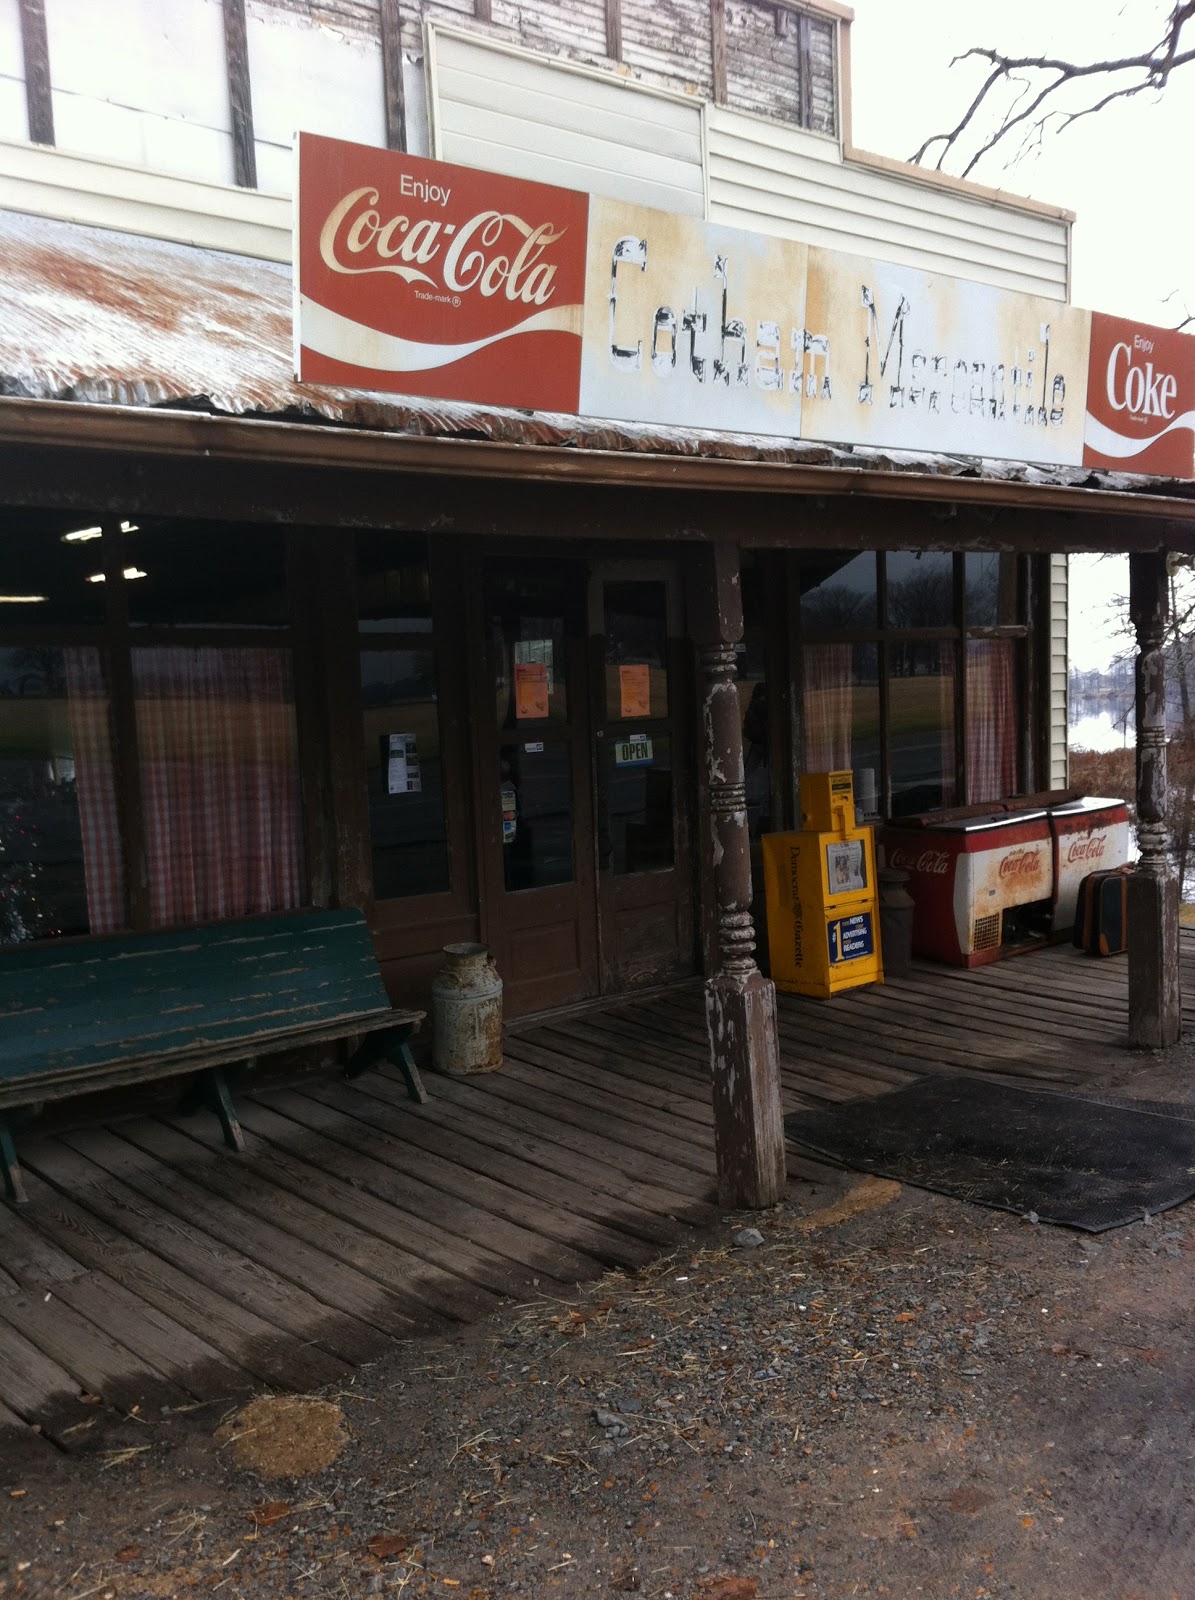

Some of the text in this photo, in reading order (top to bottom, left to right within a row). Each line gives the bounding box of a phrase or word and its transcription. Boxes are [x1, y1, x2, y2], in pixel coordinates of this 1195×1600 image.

[400, 174, 451, 207] Enjoy
[319, 186, 569, 306] Coca-Cola
[609, 234, 1067, 429] Cotham Mercantile
[1133, 334, 1154, 354] Enjoy
[1106, 341, 1178, 419] Coke
[622, 742, 649, 761] OPEN
